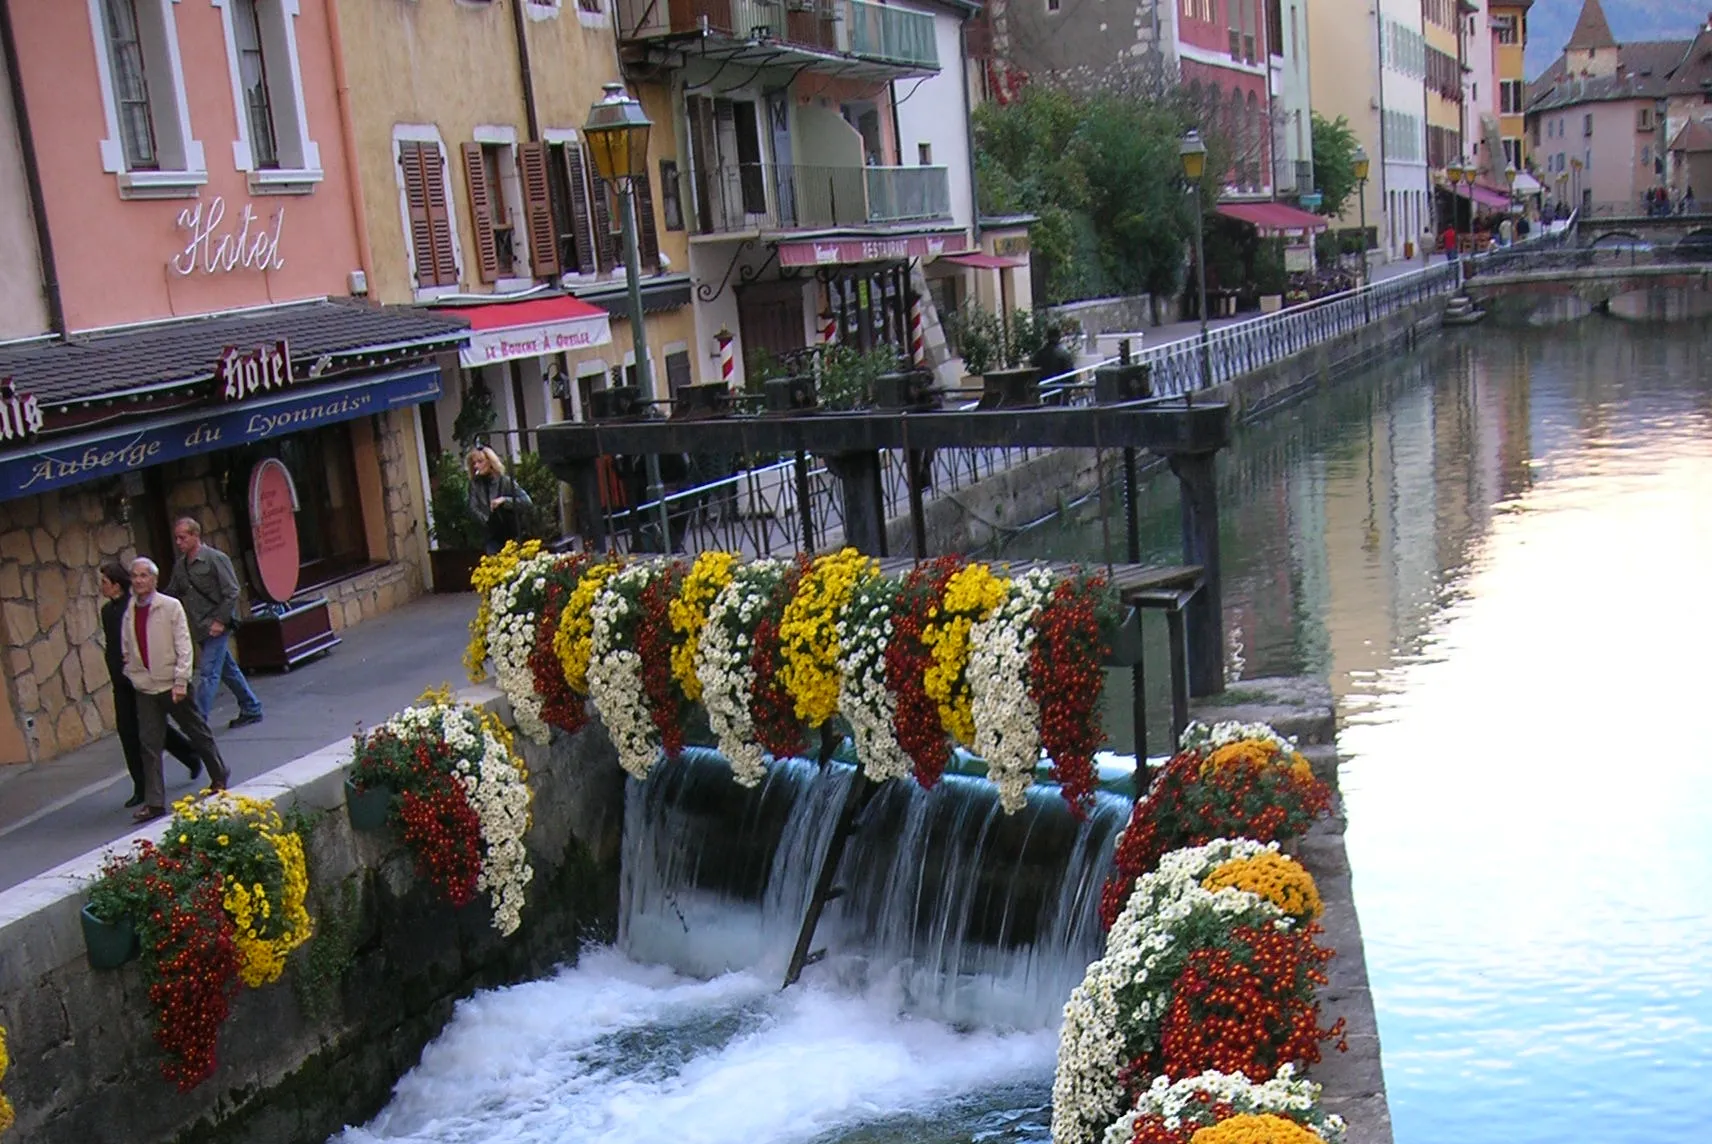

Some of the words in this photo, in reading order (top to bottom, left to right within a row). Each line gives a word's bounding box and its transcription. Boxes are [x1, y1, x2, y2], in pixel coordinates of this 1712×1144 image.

[174, 196, 285, 275] Hotel
[222, 339, 294, 400] Hotel
[19, 440, 161, 489] Auberge
[184, 423, 223, 447] du
